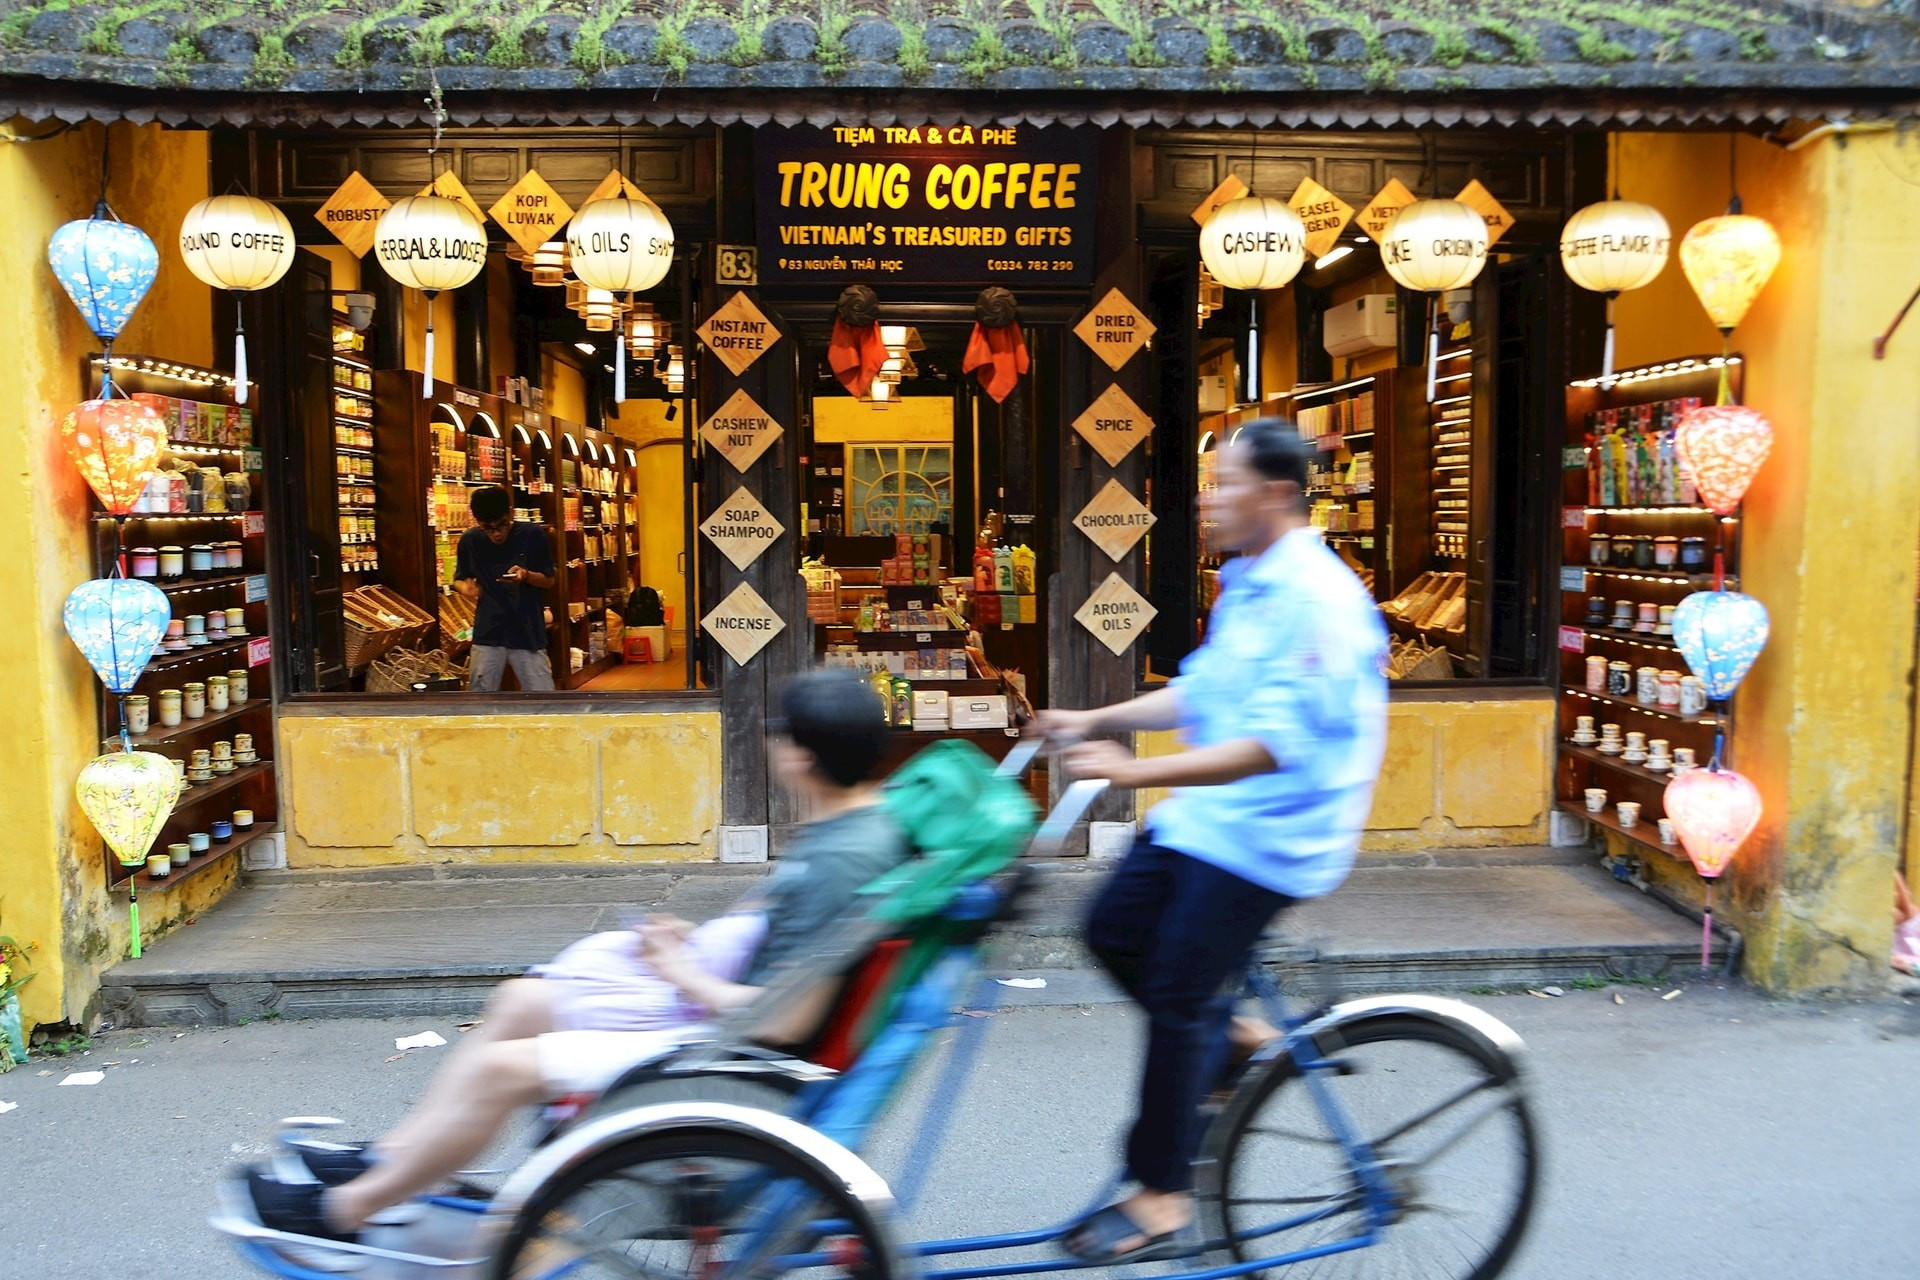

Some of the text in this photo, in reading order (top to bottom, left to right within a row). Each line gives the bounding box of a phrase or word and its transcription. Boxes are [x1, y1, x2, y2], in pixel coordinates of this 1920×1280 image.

[926, 126, 943, 145] &
[778, 161, 1081, 210] TRUNG COFFEE
[516, 195, 548, 208] KOPI
[507, 213, 556, 225] LUWAK
[779, 222, 1073, 246] VIETNAM'S TREASURED GIFTS
[231, 231, 284, 254] COFFEE
[591, 231, 630, 254] OILS
[1223, 231, 1291, 255] CASHEW
[721, 251, 752, 279] 83
[851, 257, 876, 270] THÁI
[880, 259, 903, 273] HỌC
[994, 260, 1074, 271] 0334 782 290
[711, 319, 767, 334] INSTANT
[1095, 315, 1135, 327] DRIED
[712, 336, 763, 350] COFFEE
[1096, 331, 1134, 343] FRUIT
[712, 418, 769, 431] CASHEW
[1095, 419, 1133, 431] SPICE
[728, 434, 754, 446] NUT
[725, 509, 760, 522] SOAP
[1081, 513, 1149, 528] CHOCOLATE
[709, 525, 774, 539] SHAMPOO
[1092, 602, 1139, 616] AROMA
[715, 617, 772, 630] INCENSE
[1102, 618, 1132, 631] OILS
